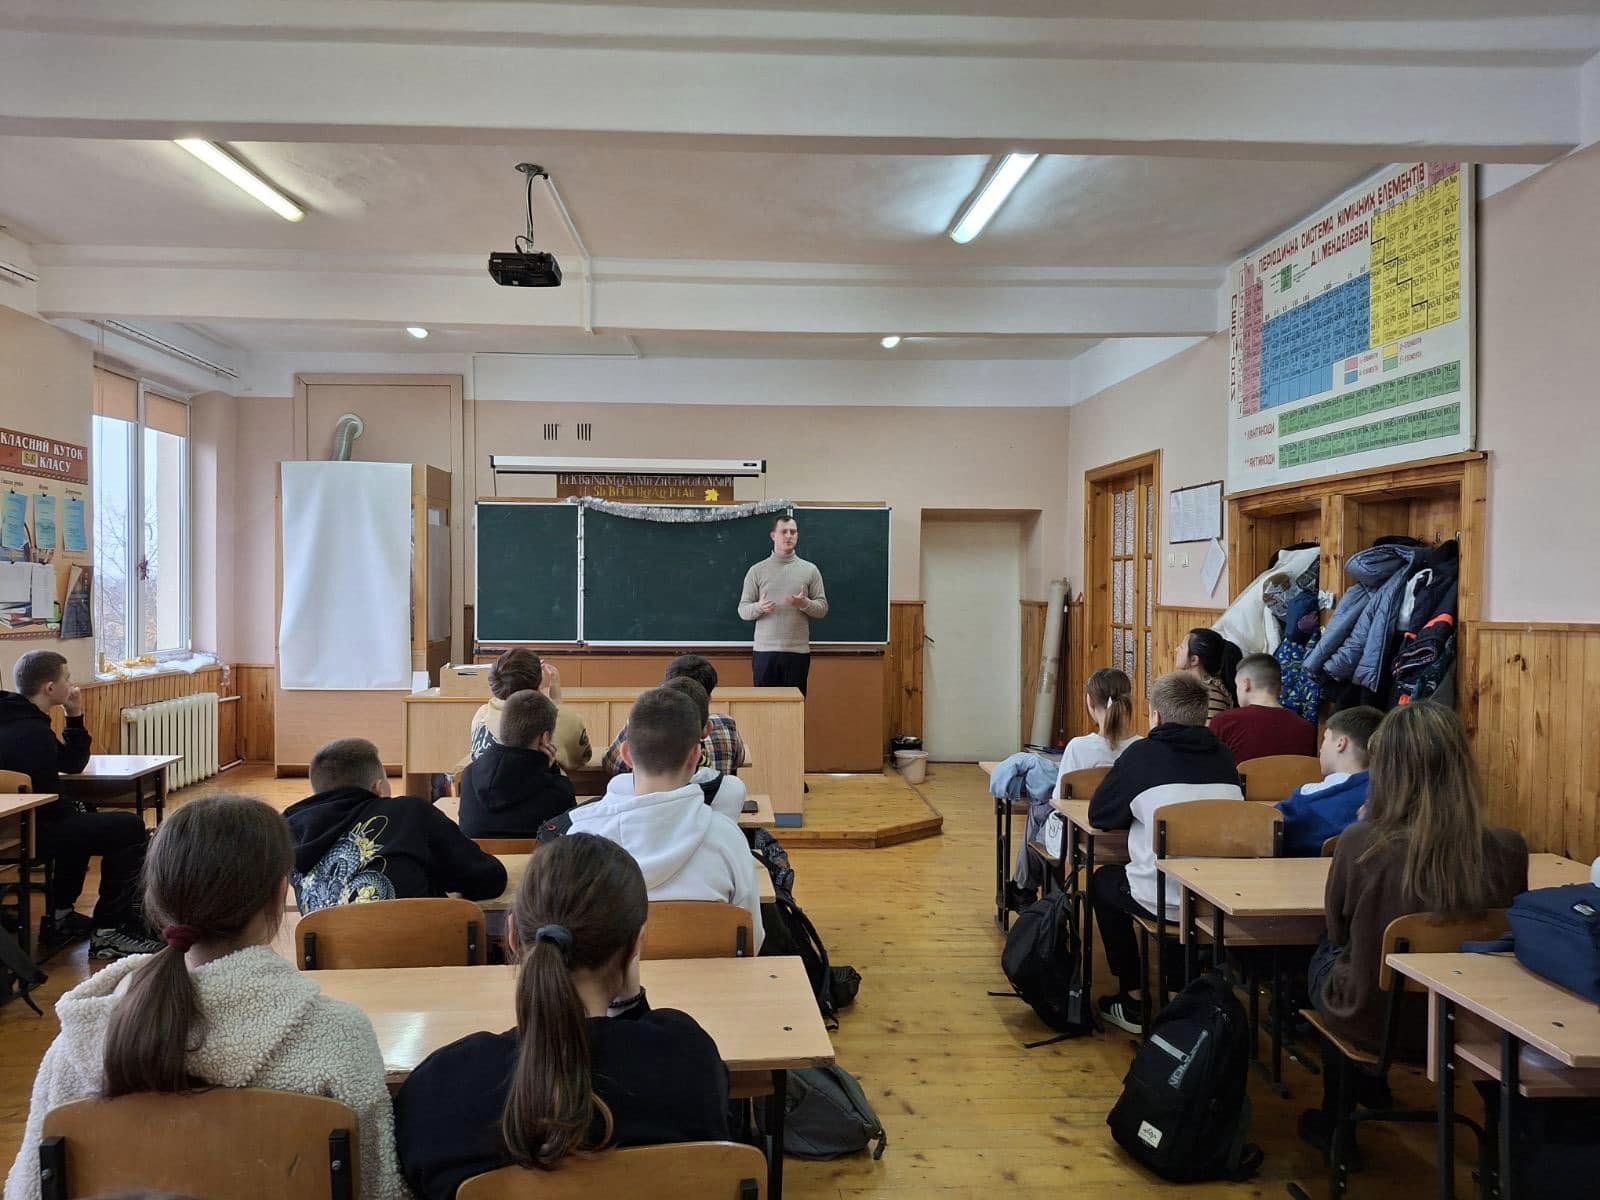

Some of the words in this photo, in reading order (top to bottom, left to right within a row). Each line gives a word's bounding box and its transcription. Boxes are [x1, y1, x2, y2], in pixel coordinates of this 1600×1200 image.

[1258, 237, 1299, 272] ПЕРІОДИЧНА
[1301, 216, 1334, 249] СИСТЕМА
[1337, 191, 1376, 228] ХІМІЧНИХ
[1377, 162, 1425, 205] ЕЛЕМЕНТІВ
[0, 431, 50, 453] КЛАСНИЙ
[53, 443, 83, 460] КУТОК
[40, 456, 72, 473] КЛАСУ
